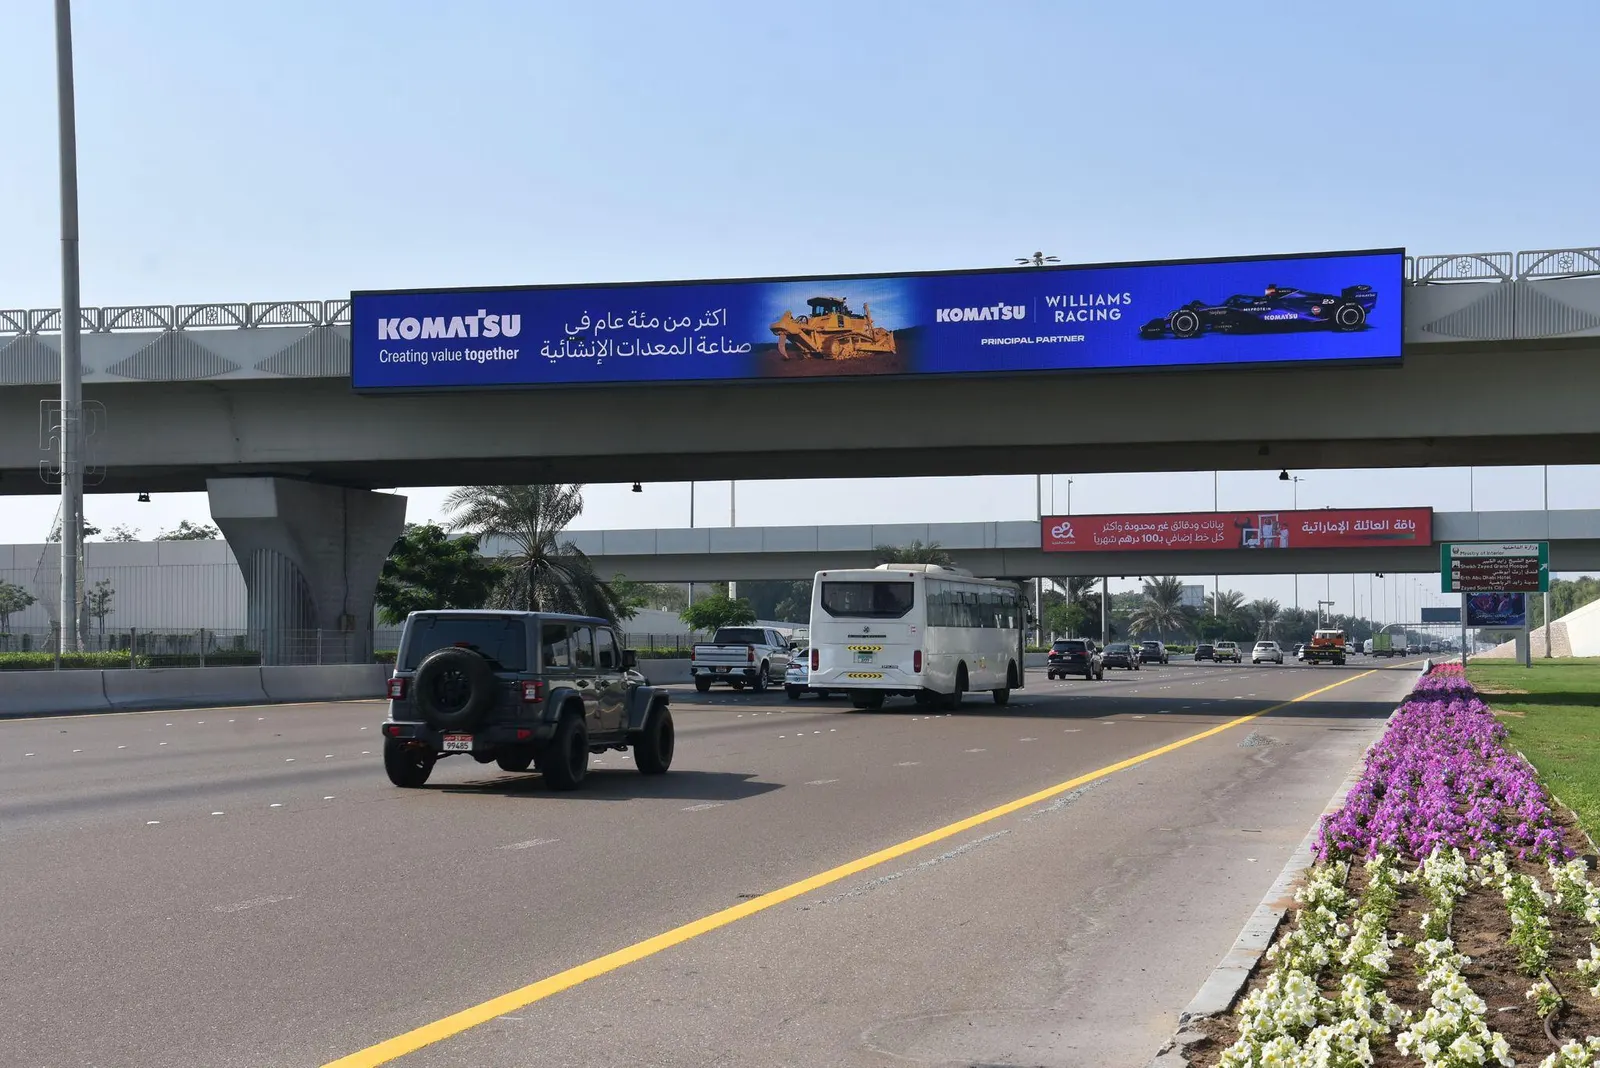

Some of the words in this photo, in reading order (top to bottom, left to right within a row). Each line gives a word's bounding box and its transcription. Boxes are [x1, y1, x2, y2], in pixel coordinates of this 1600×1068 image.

[1045, 292, 1131, 308] WILLIAMS
[627, 309, 660, 328] مئة
[694, 308, 727, 331] اكثر
[936, 302, 1026, 323] KOMATSU
[1054, 308, 1121, 323] RACING
[1264, 312, 1298, 320] KOMATSU
[378, 308, 521, 340] KOMATSU
[564, 310, 591, 340] في
[594, 311, 624, 336] عام
[663, 314, 691, 331] من
[616, 336, 692, 356] المعدات
[696, 335, 752, 354] صناعة
[980, 336, 1034, 346] PRINCIPAL
[1036, 334, 1085, 344] PARTNER
[379, 348, 428, 365] Creating
[431, 348, 462, 362] value
[464, 346, 520, 364] together
[540, 339, 613, 365] الإنشائية
[1124, 522, 1155, 530] محدودة
[1157, 522, 1169, 531] غير
[1301, 522, 1349, 534] الإماراتية
[1354, 520, 1389, 530] العائلة
[1393, 520, 1416, 531] باقة
[1118, 534, 1140, 544] درهم
[1194, 533, 1209, 542] خط
[1211, 532, 1224, 543] كل
